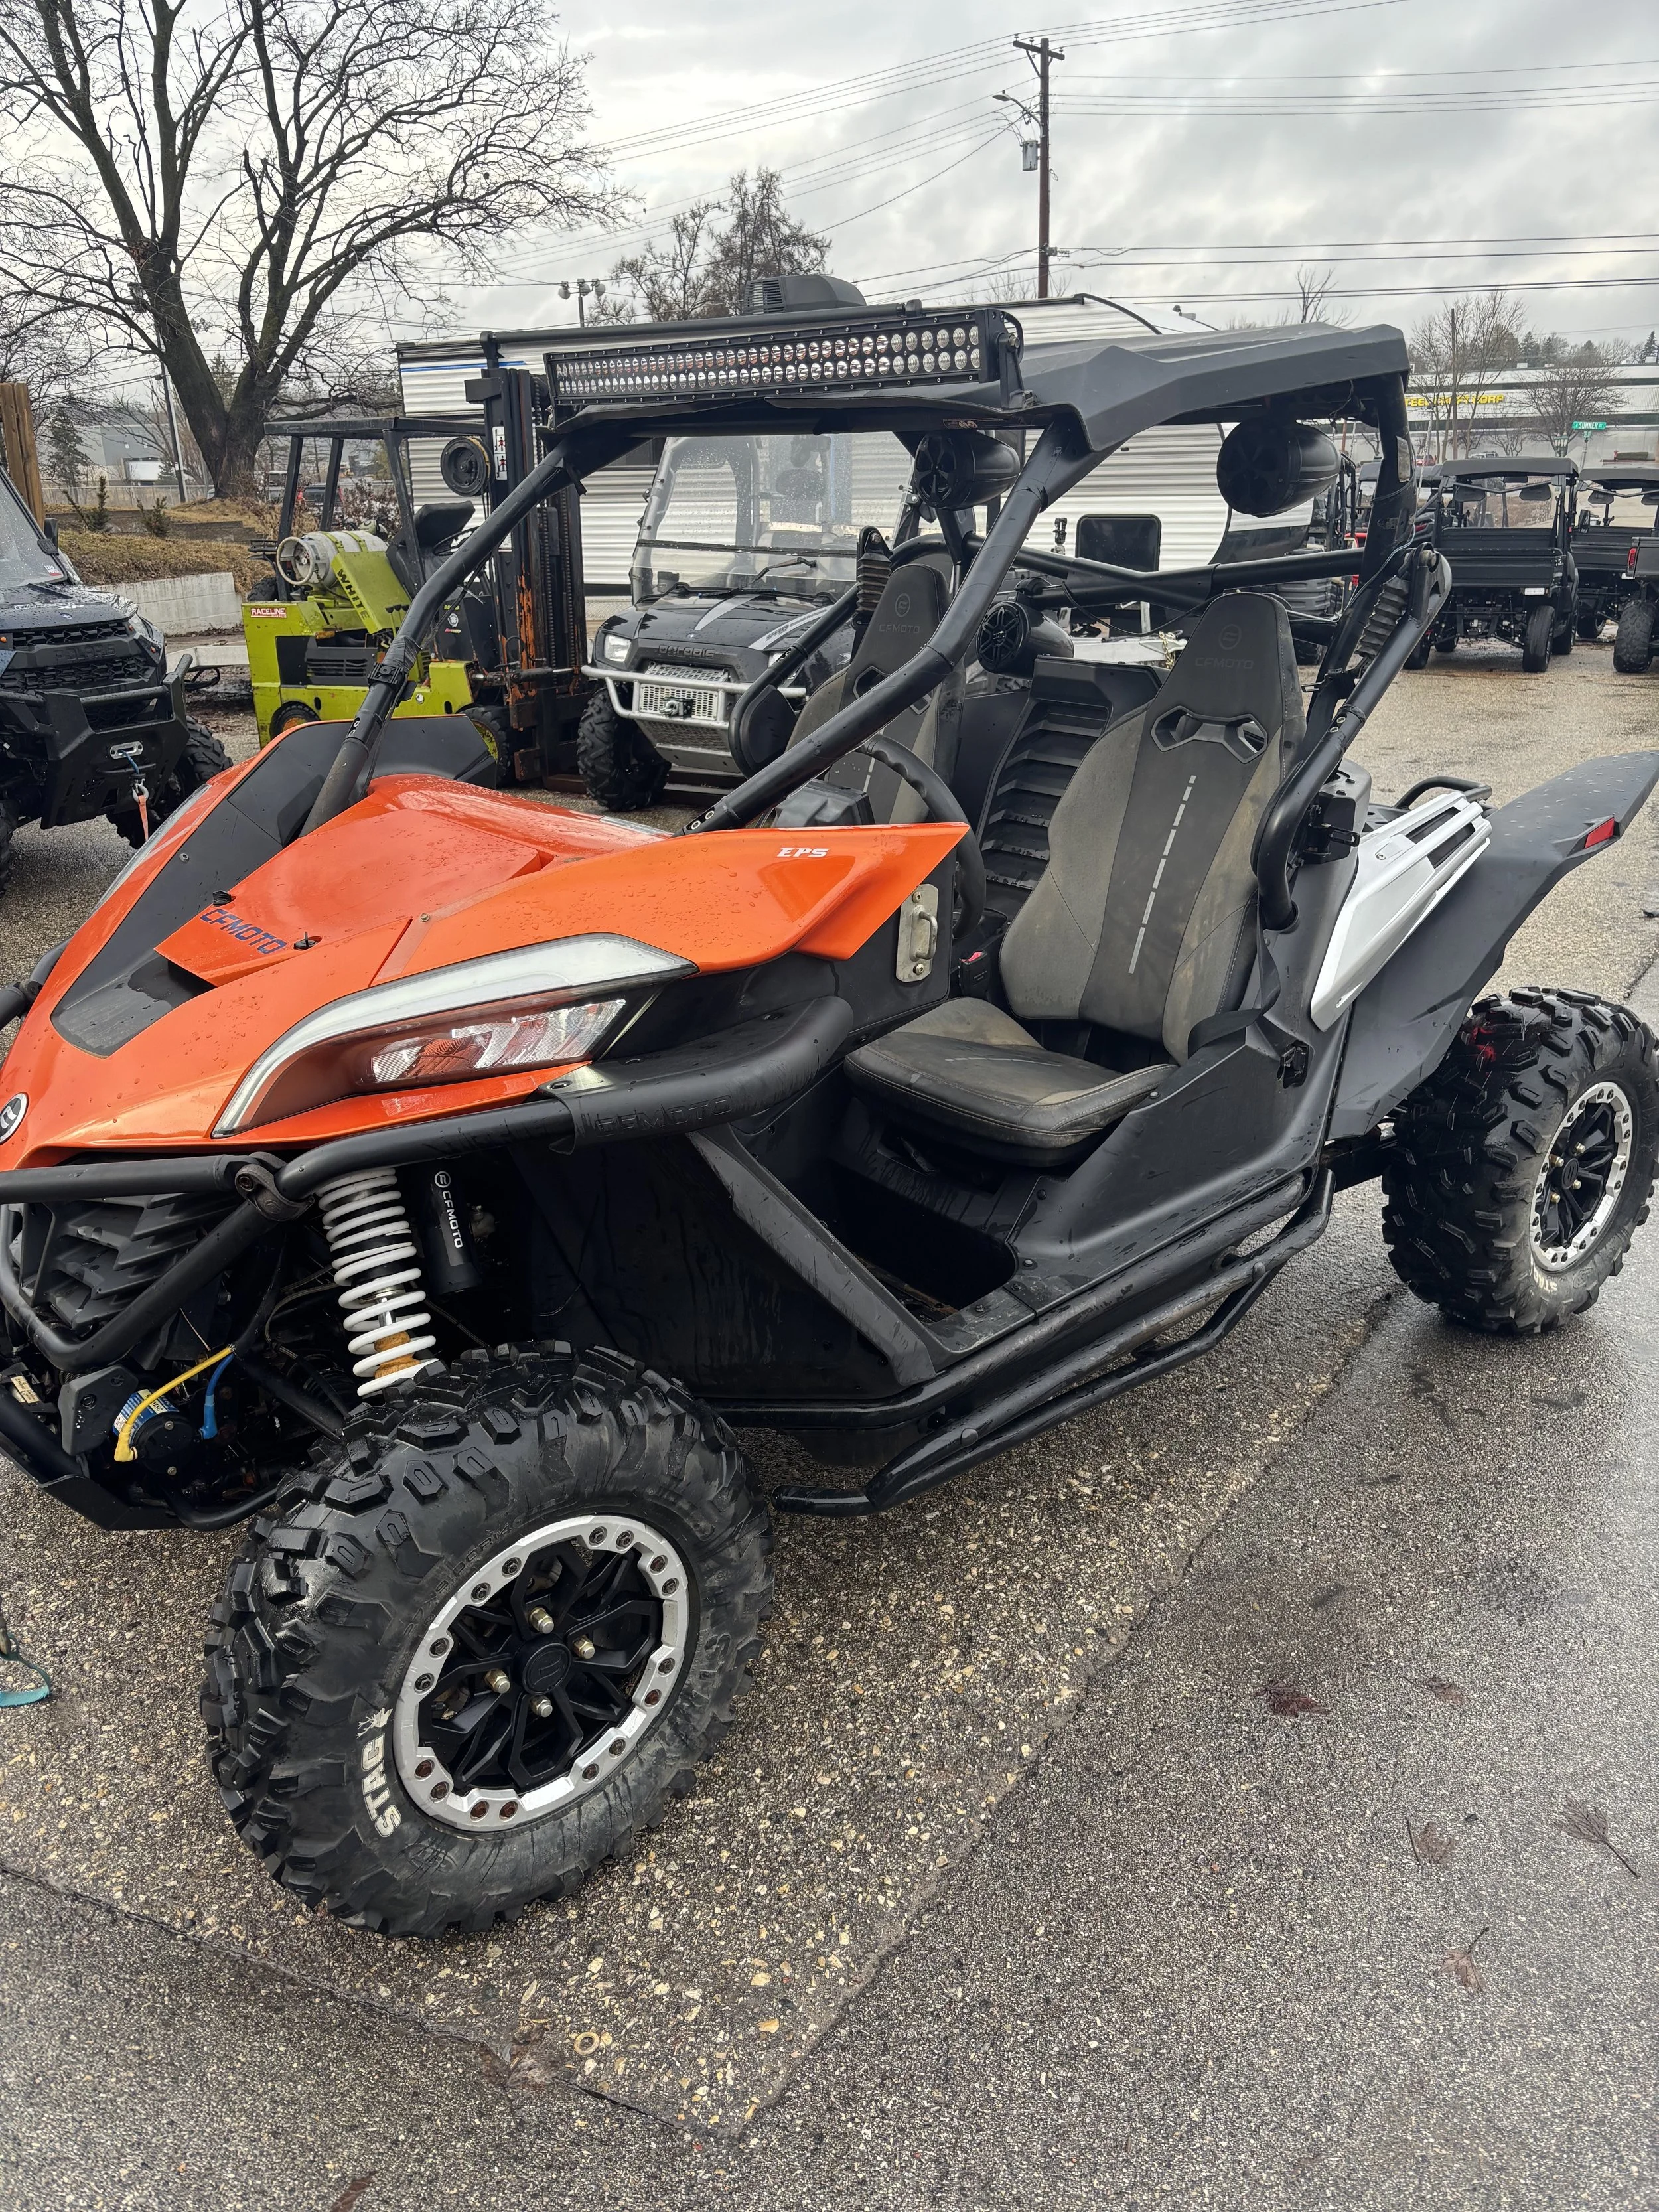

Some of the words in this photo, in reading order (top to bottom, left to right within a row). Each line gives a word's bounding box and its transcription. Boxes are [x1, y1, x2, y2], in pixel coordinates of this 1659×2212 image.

[337, 568, 371, 620] WHITE
[879, 624, 920, 634] CFMOTO
[658, 644, 715, 660] POLARIS
[1195, 657, 1254, 670] CFMOTO
[776, 847, 830, 857] EPS
[200, 908, 287, 954] CFMOTO
[595, 1095, 731, 1137] CFMOTO
[442, 1190, 463, 1248] CFMOTO
[361, 1732, 401, 1838] STAG
